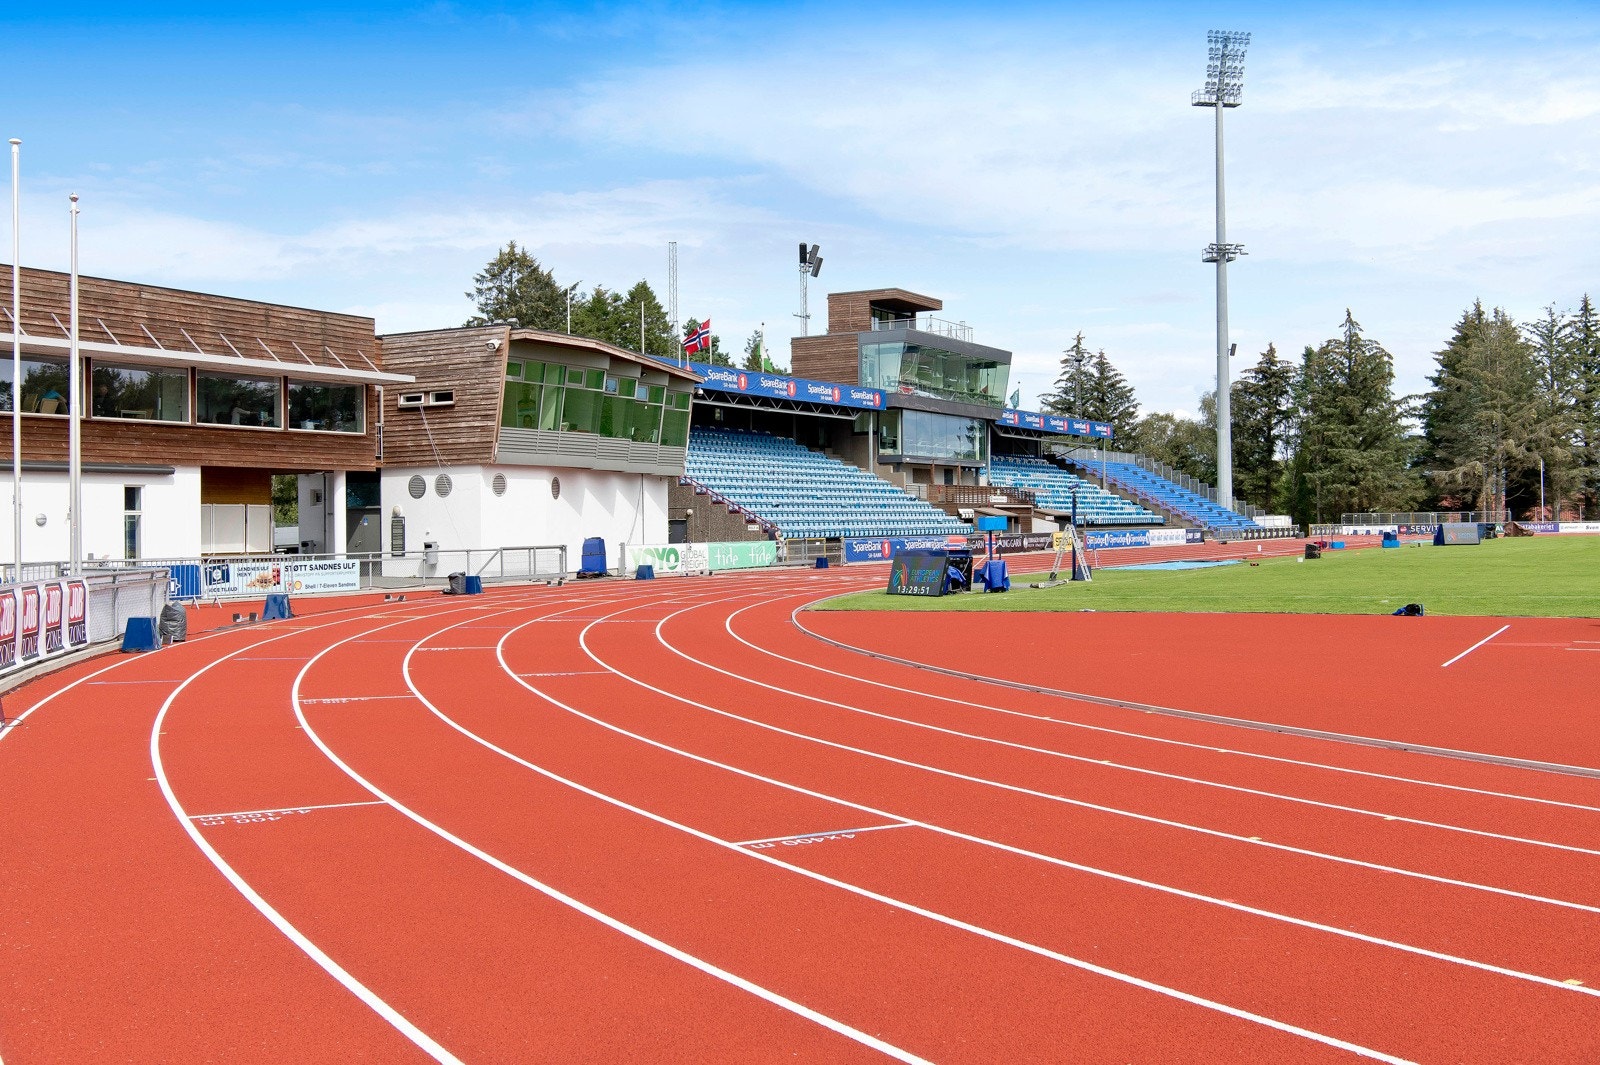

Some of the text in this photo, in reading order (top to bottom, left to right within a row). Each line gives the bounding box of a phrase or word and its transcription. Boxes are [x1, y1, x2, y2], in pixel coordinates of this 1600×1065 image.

[707, 369, 738, 382] SpareBank
[760, 377, 788, 390] SpareBank
[807, 384, 833, 396] SpareBank
[850, 389, 874, 400] SpareBank
[852, 540, 882, 553] SpareBank
[628, 547, 680, 571] YOYO
[714, 546, 739, 566] tide
[748, 545, 771, 565] tide
[284, 562, 356, 572] STØTT SANDNES ULF
[897, 585, 930, 595] 13:29:51
[69, 586, 84, 619] JOB
[46, 629, 62, 651] ZONE
[69, 623, 86, 644] ZONE
